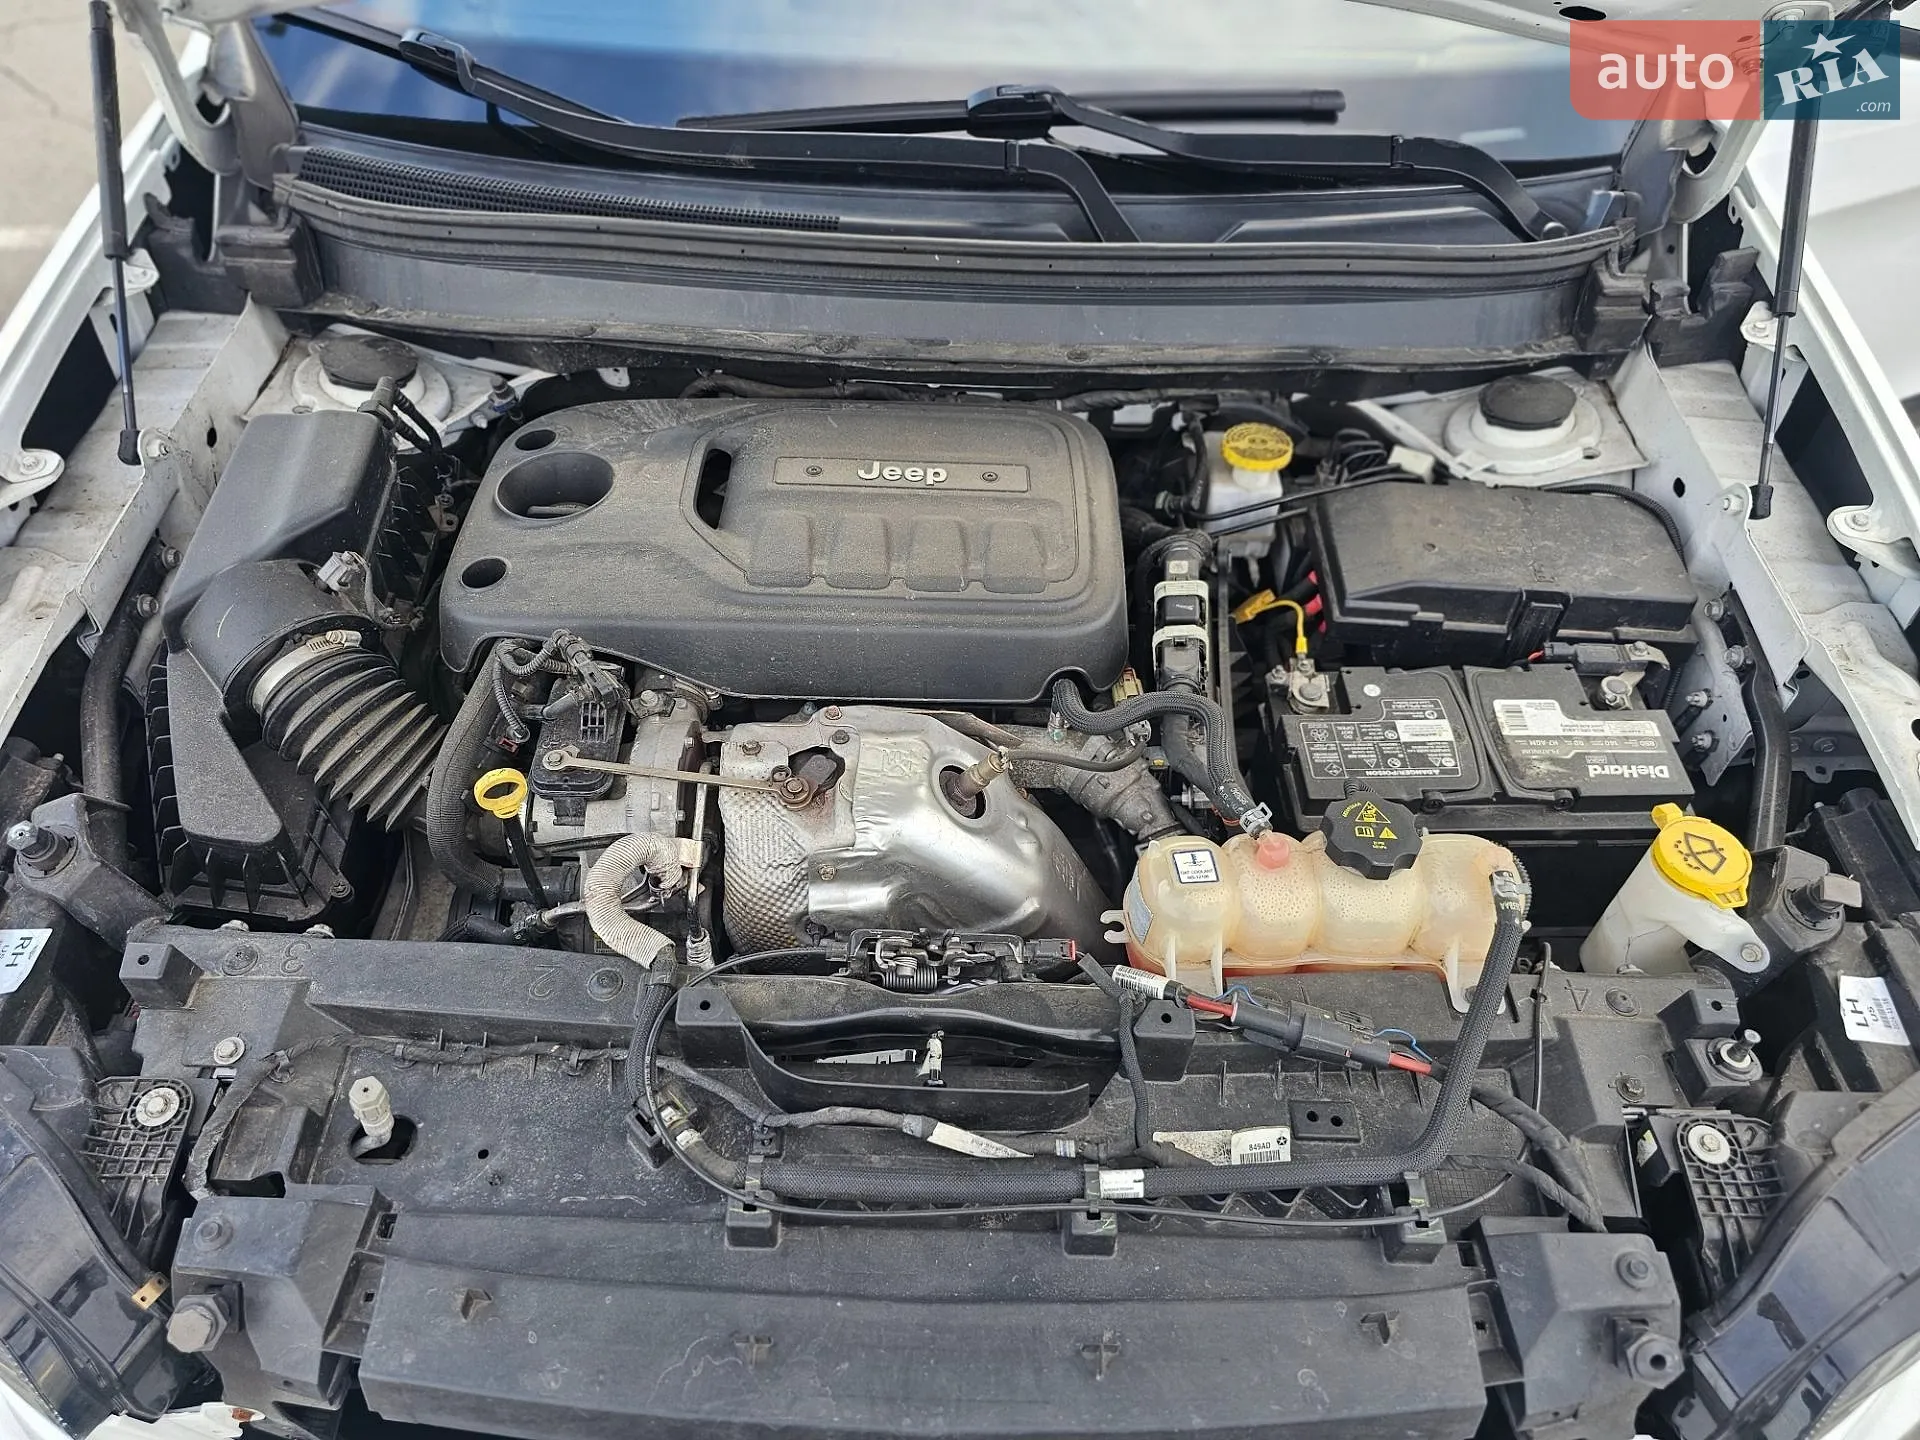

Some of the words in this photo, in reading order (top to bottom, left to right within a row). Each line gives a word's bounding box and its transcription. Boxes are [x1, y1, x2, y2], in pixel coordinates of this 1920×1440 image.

[857, 460, 948, 486] Jeep
[1588, 764, 1670, 779] DieHard
[5, 936, 33, 968] RH
[1845, 998, 1869, 1028] LH
[1866, 1005, 1879, 1022] US
[1248, 1141, 1271, 1152] 849AD
